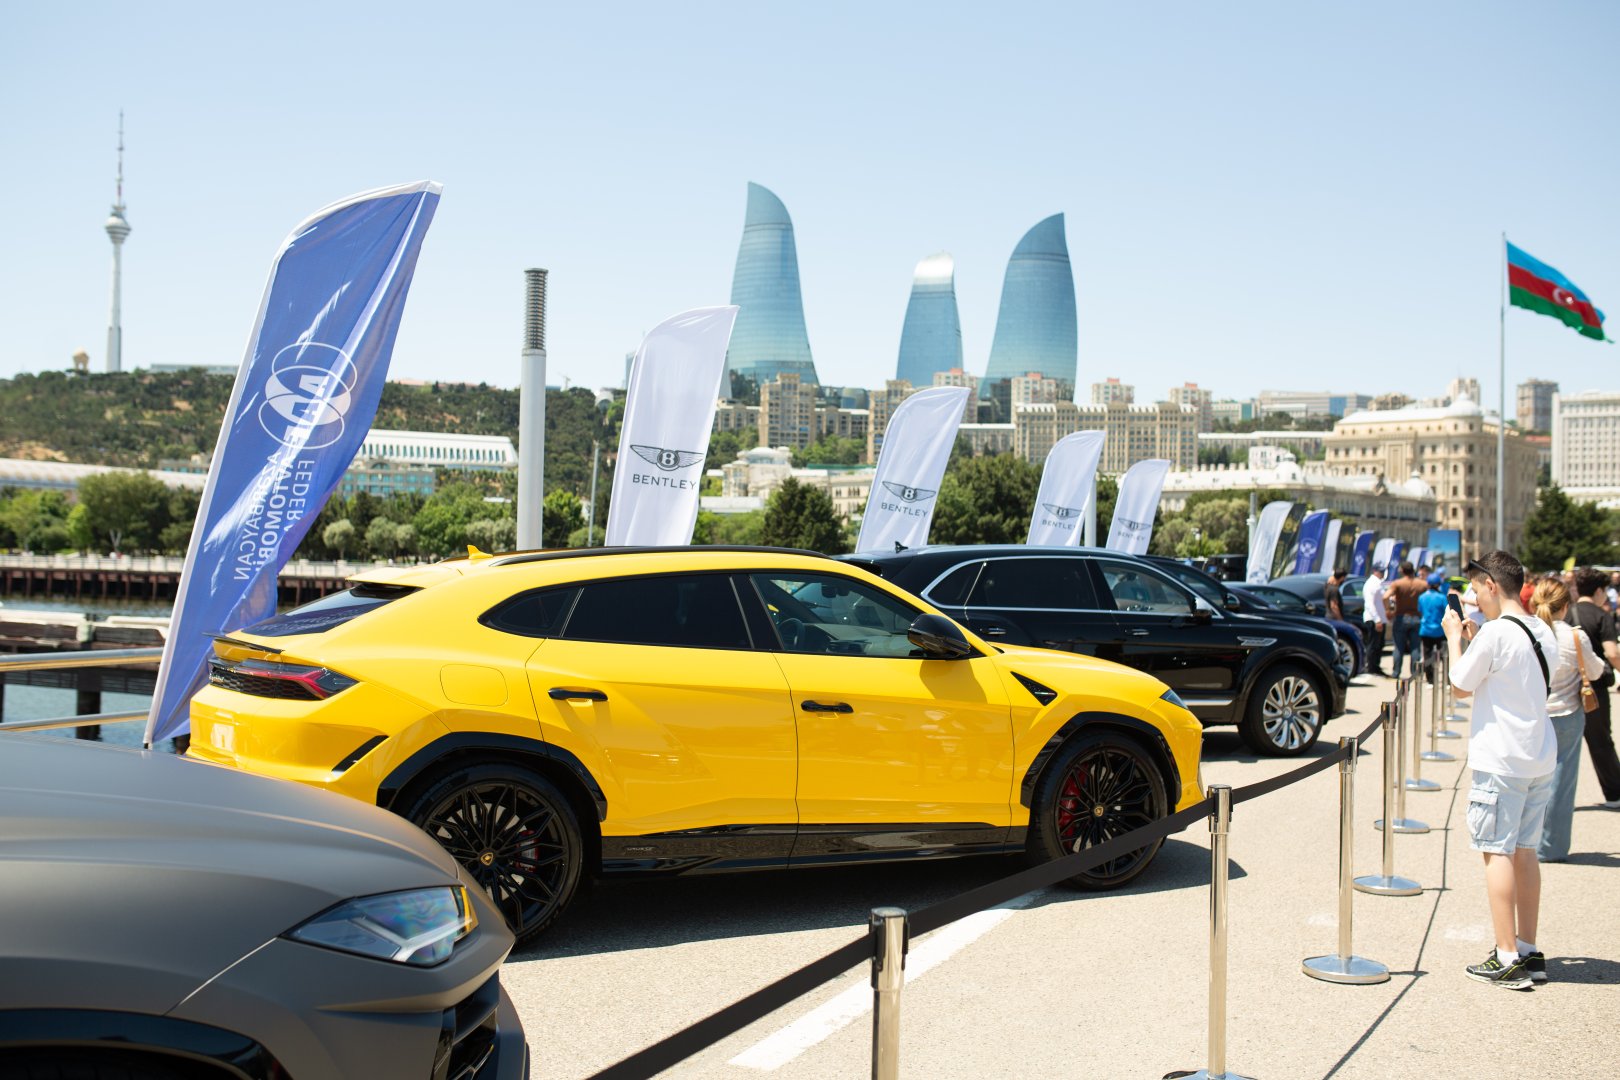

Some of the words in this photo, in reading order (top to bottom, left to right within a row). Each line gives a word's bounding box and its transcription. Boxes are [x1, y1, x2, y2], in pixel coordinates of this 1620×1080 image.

[632, 473, 697, 490] BENTLEY
[880, 502, 928, 518] BENTLEY
[1041, 519, 1076, 531] BENTLE
[1117, 531, 1146, 542] BENTEY
